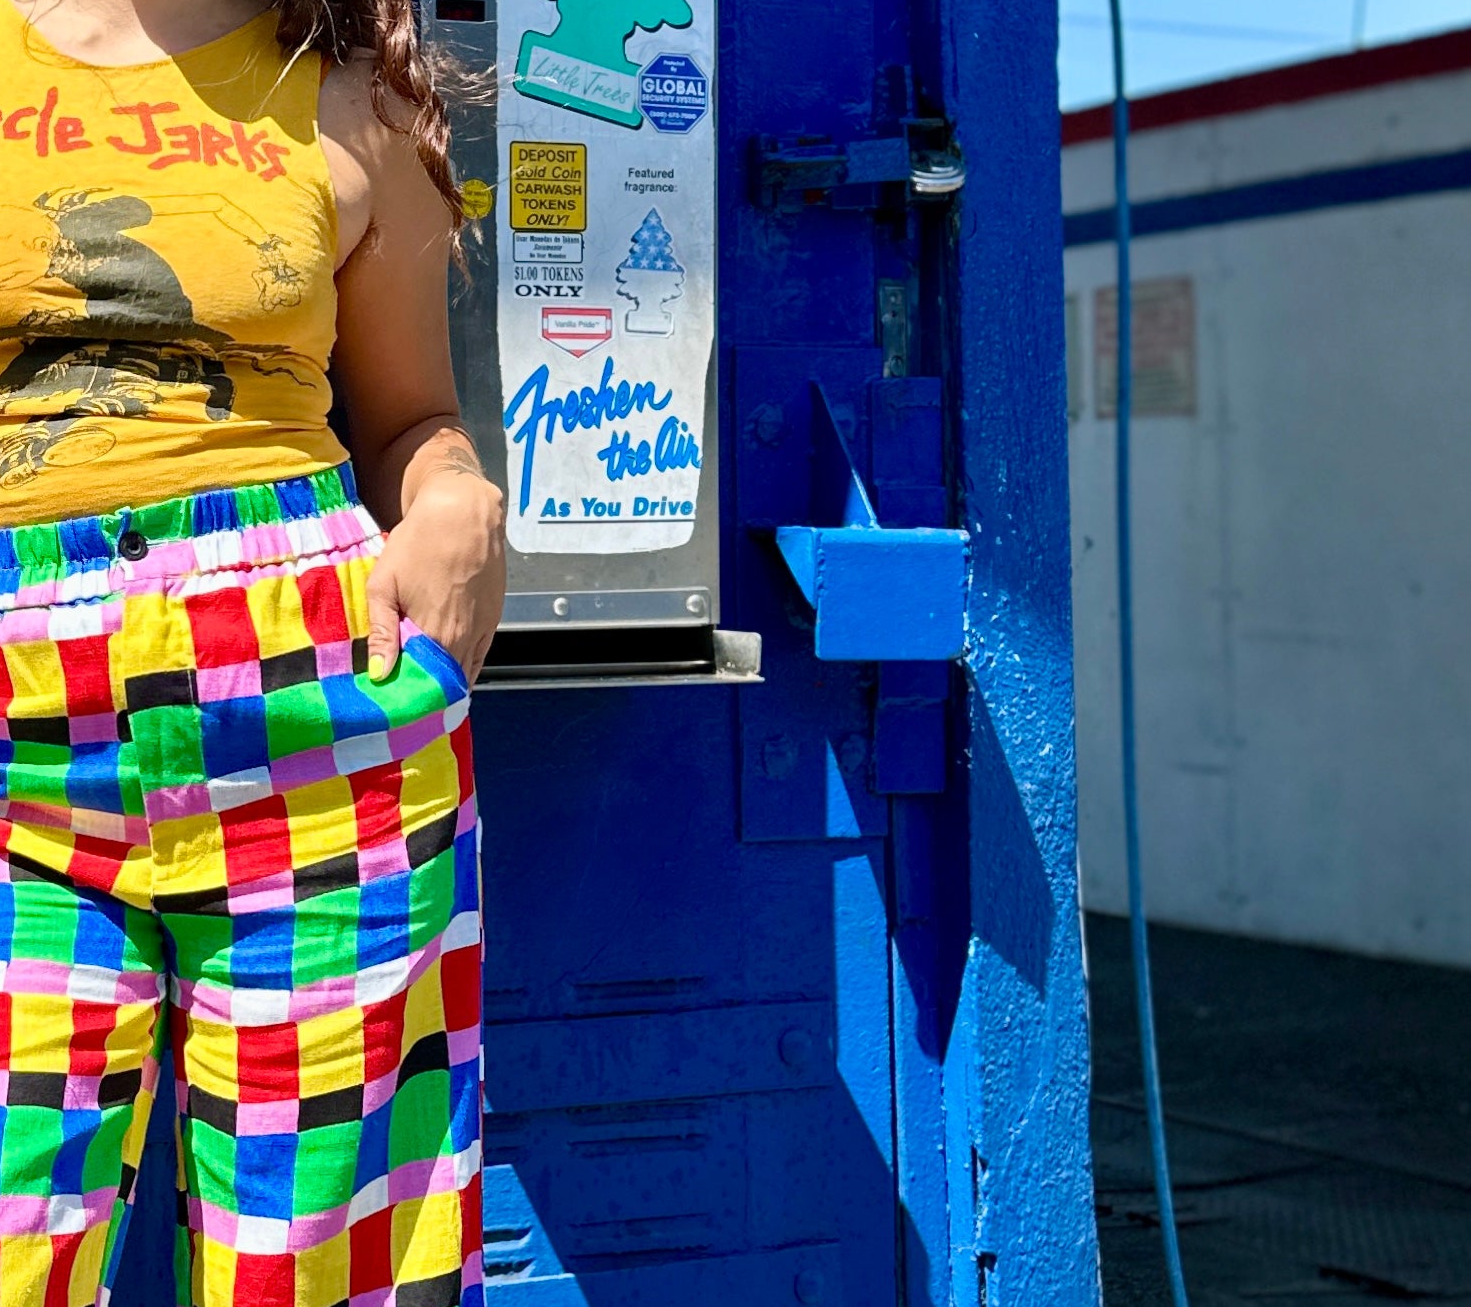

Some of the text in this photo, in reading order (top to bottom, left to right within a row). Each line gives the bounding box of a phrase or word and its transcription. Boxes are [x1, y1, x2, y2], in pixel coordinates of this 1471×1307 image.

[533, 57, 629, 104] Little Trees
[642, 77, 705, 97] GLOBAL
[518, 148, 578, 163] DEPOSIT
[515, 165, 582, 179] Gold Coin
[628, 167, 675, 179] Featured
[514, 183, 583, 196] CARWASH
[624, 181, 678, 195] fragrance:
[520, 198, 576, 211] TOKENS
[526, 213, 570, 227] ONLY!
[514, 266, 584, 282] $1.00 TOKENS
[515, 284, 584, 297] ONLY
[503, 356, 673, 517] Freshen
[597, 415, 702, 482] the Air
[540, 495, 695, 518] As You Drive
